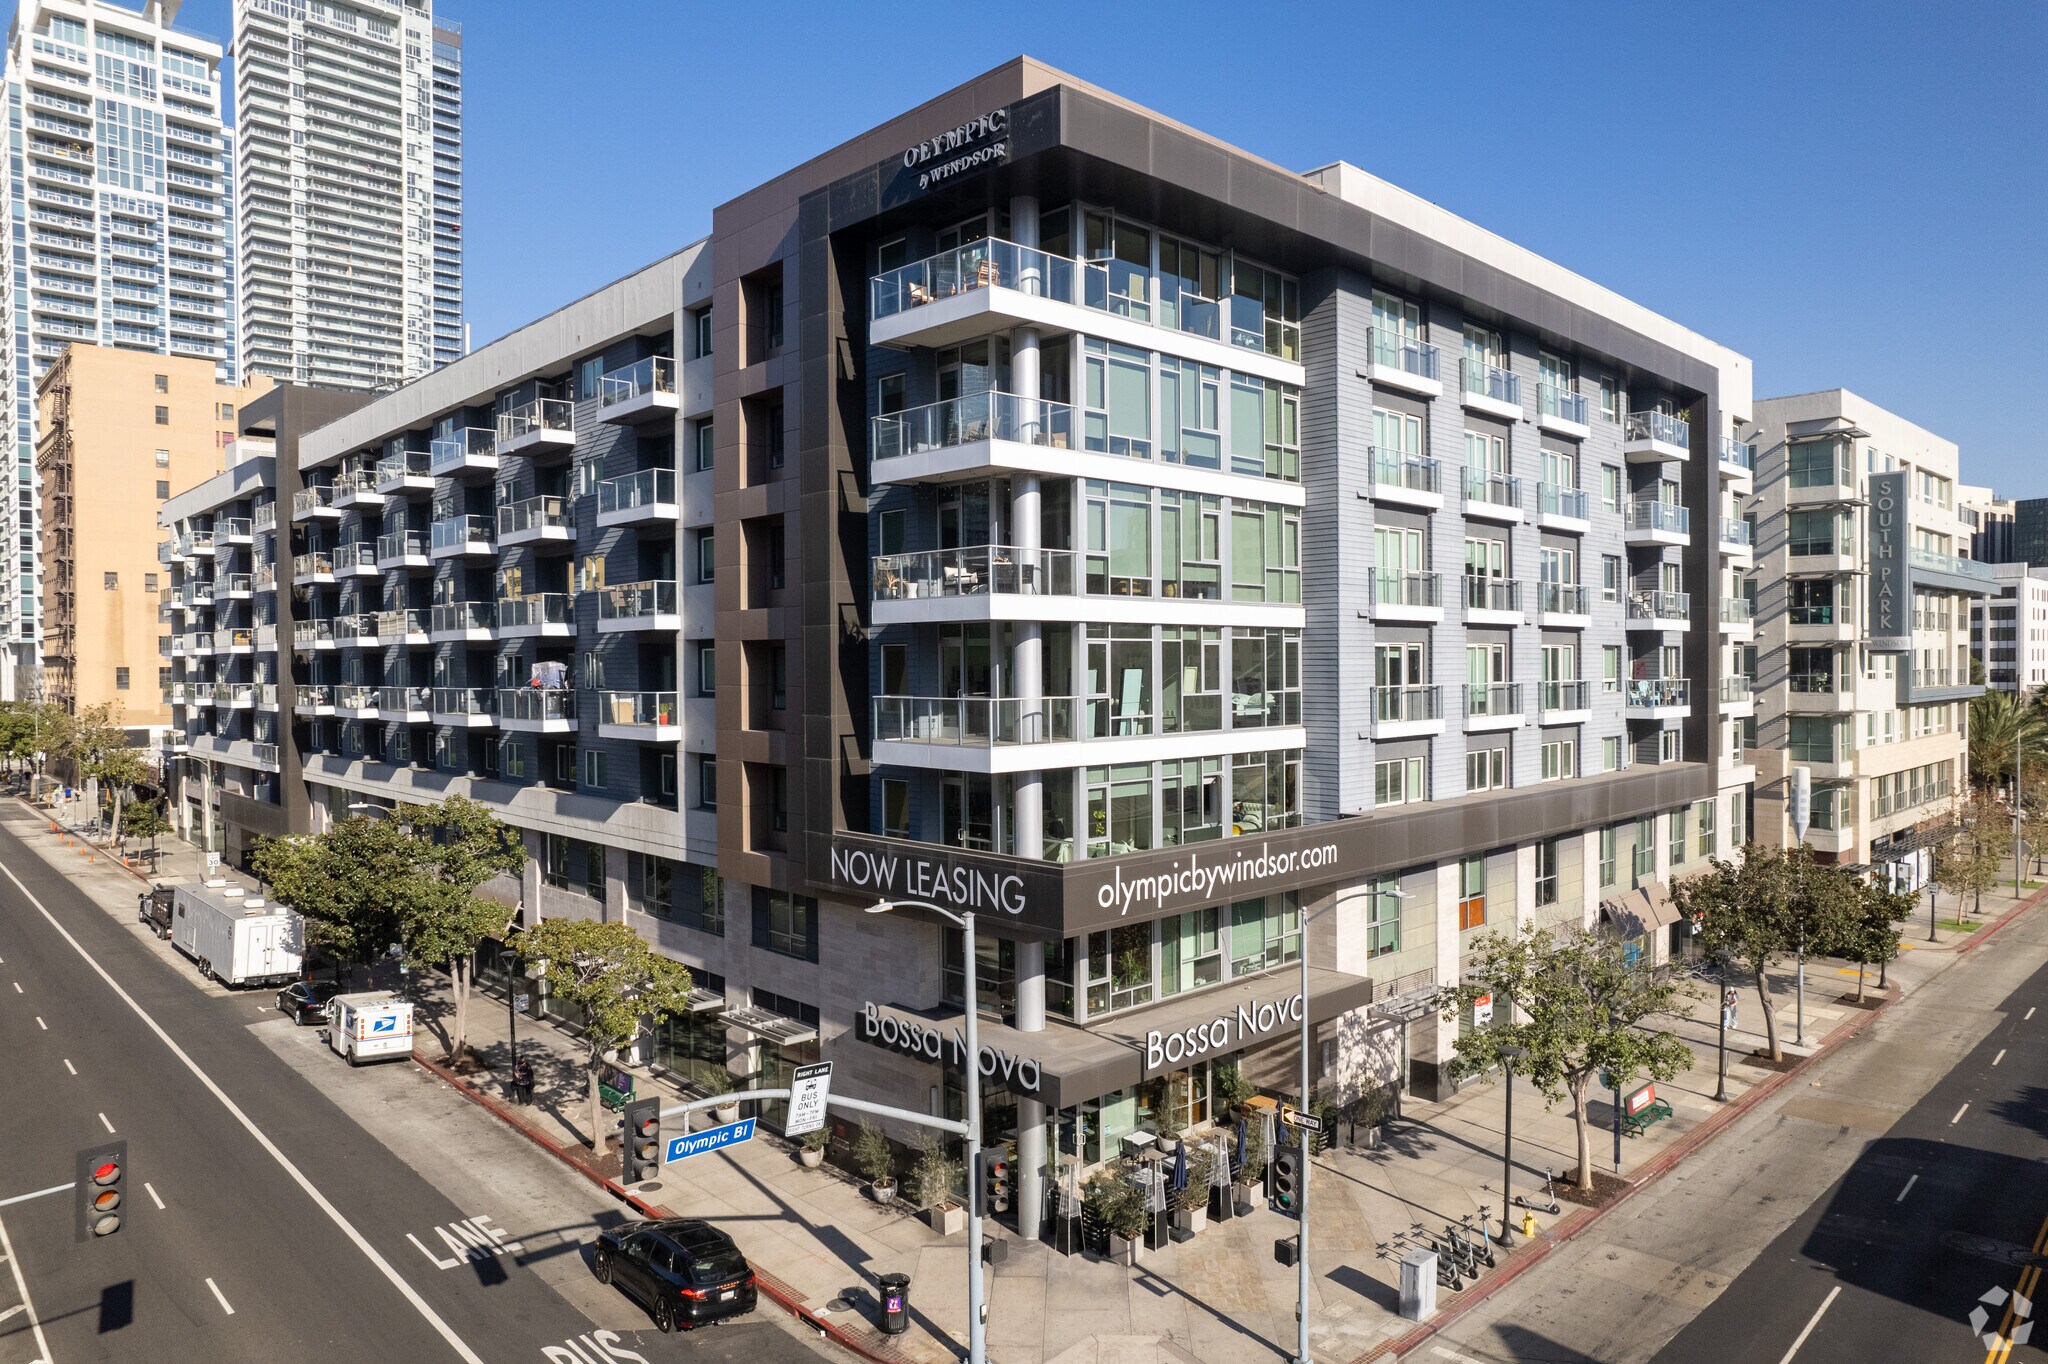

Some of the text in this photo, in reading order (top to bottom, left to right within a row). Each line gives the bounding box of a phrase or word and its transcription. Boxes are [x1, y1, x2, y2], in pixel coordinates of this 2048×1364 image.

[903, 109, 1006, 168] OLYMPIC
[930, 143, 1006, 183] WINDSOR
[1877, 481, 1894, 629] SOUTH PARK
[831, 846, 1026, 915] NOW LEASING
[1098, 842, 1338, 915] olympicbywindsor.com
[864, 1001, 1041, 1091] Bossa Nova
[1146, 1015, 1229, 1071] Bossa
[797, 1066, 829, 1078] RIGHT LANE
[801, 1091, 818, 1102] BUS
[797, 1100, 819, 1111] ONLY
[1294, 1115, 1317, 1126] ONE WAY
[675, 1130, 729, 1155] Olympic
[406, 1215, 525, 1270] LANE
